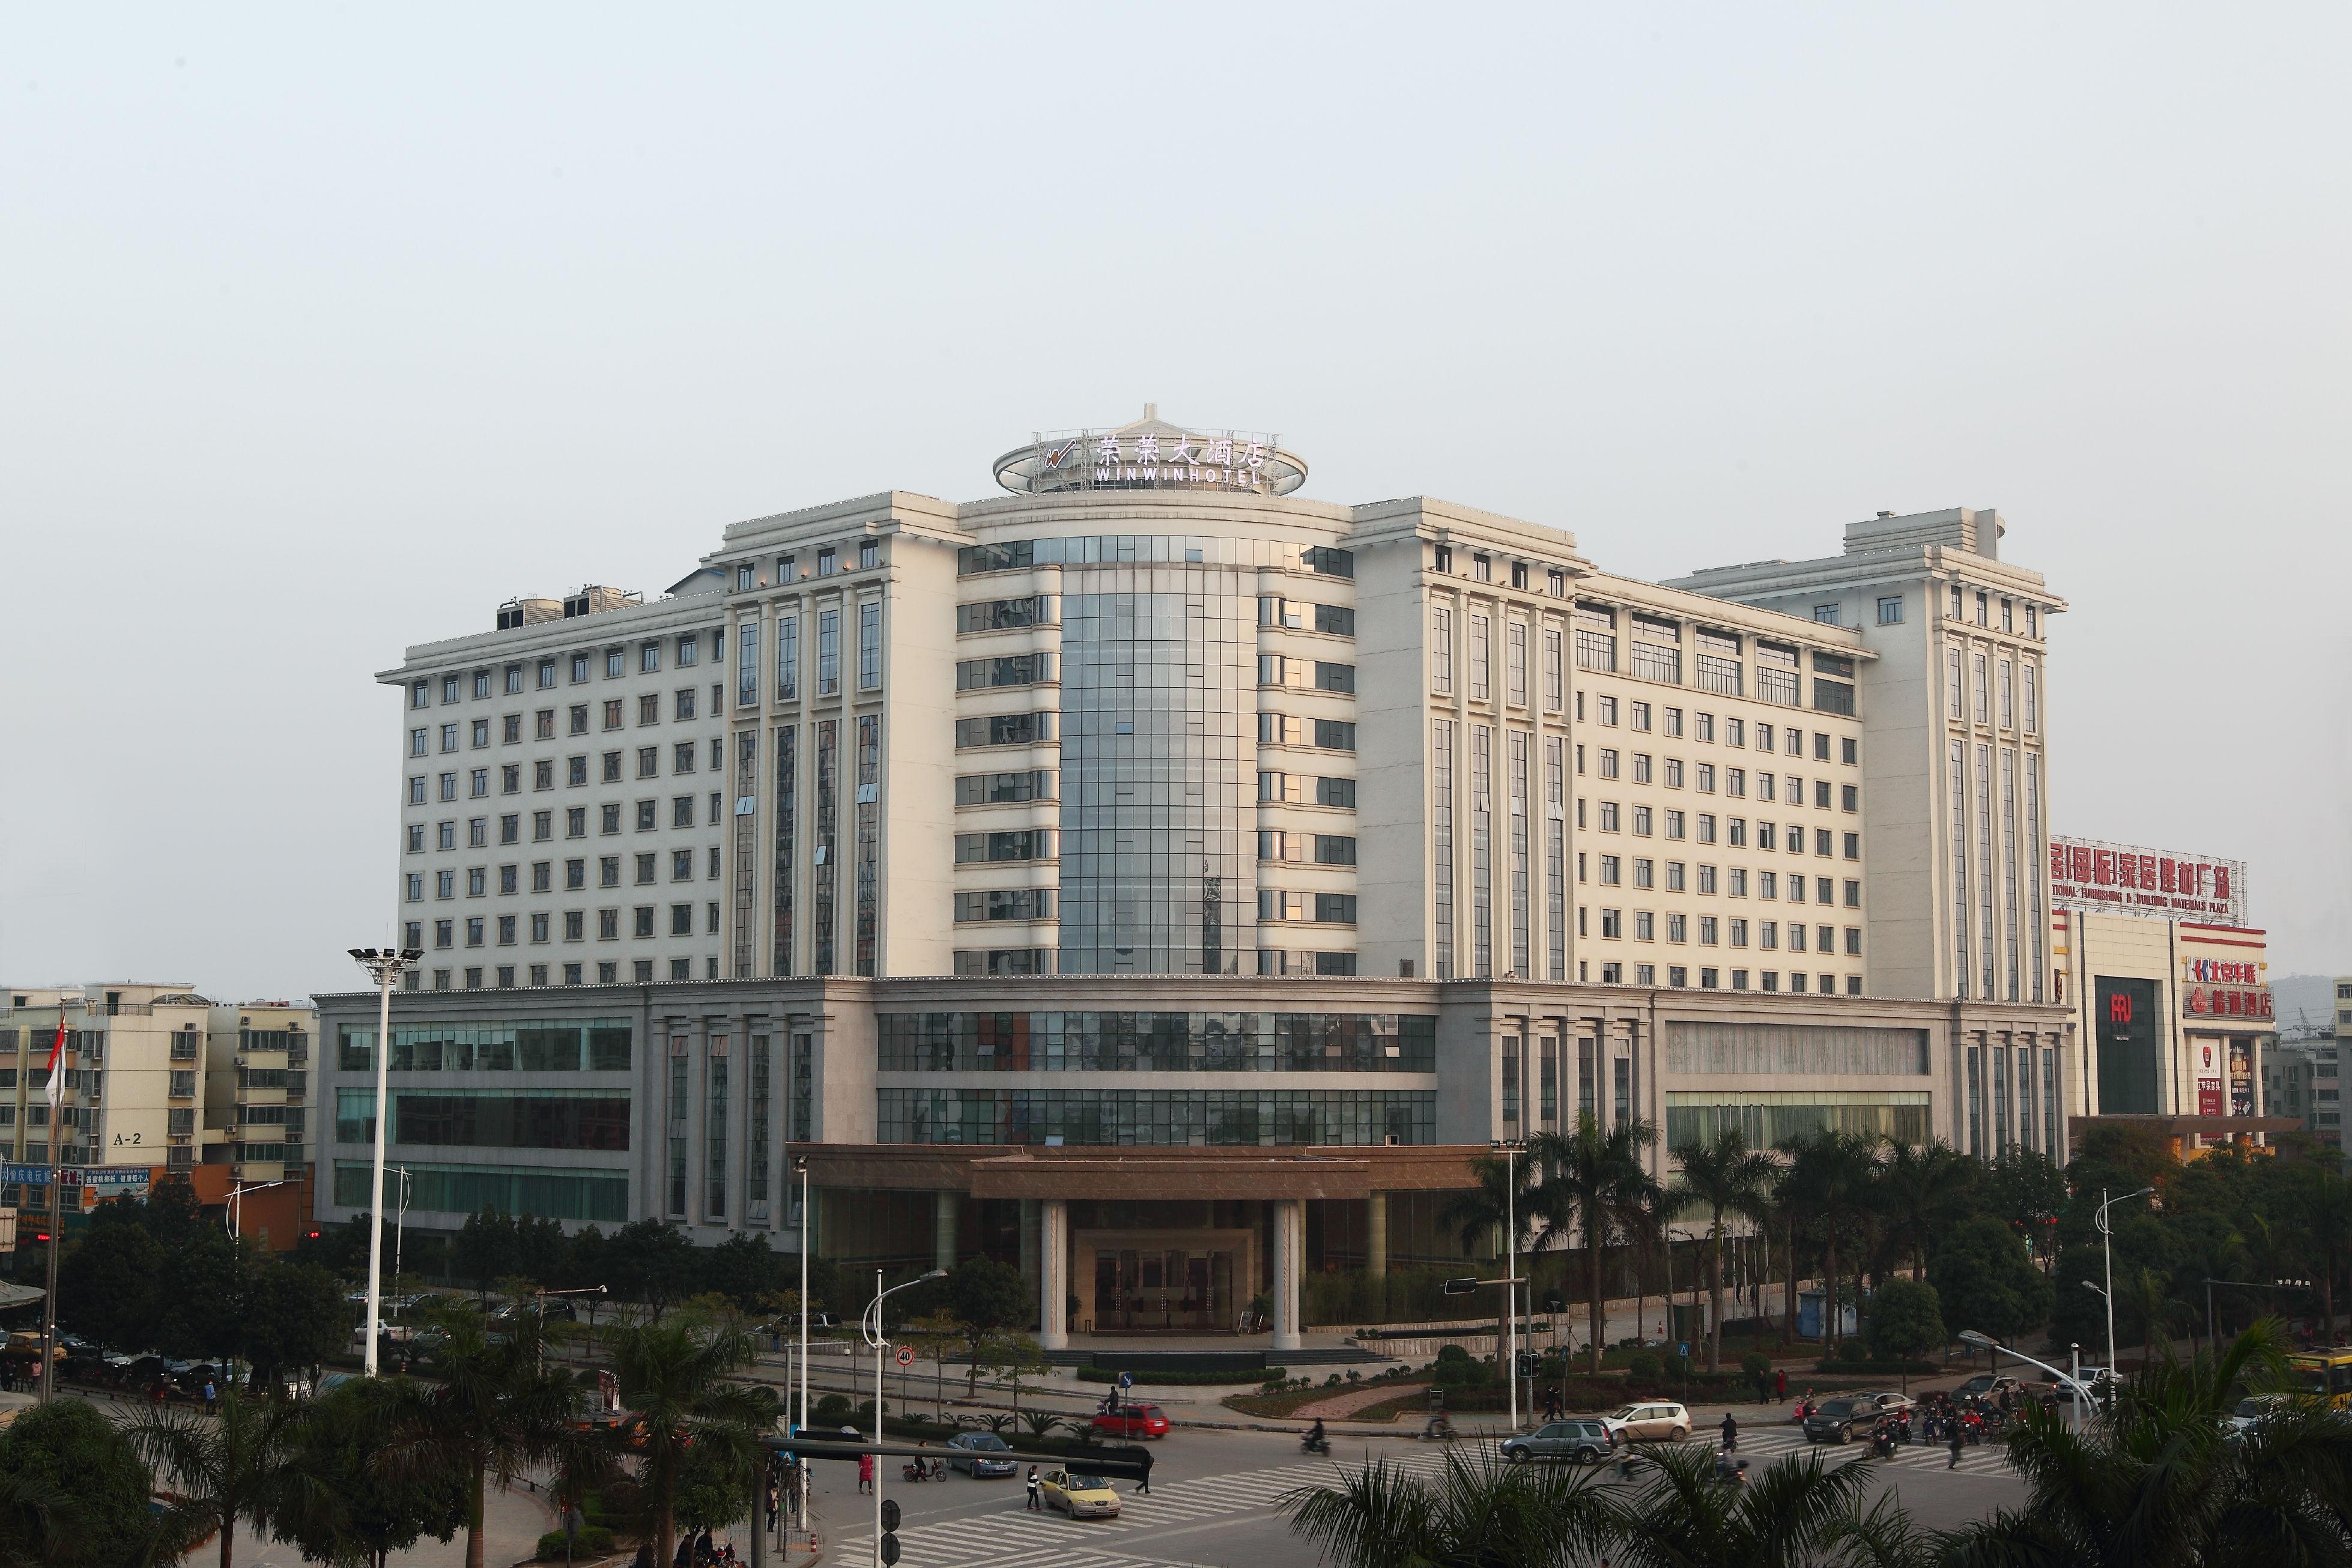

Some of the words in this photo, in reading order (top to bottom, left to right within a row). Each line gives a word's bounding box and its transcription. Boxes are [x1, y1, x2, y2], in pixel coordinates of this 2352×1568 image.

[1097, 433, 1264, 467] 荣荣大酒店
[2082, 887, 2123, 901] FURNISHING
[2127, 893, 2132, 903] &
[2136, 893, 2168, 907] BUILDING
[2171, 897, 2206, 912] MATERIALS
[2209, 902, 2229, 914] PLAZA
[2210, 961, 2256, 984] 北京华联
[2213, 989, 2272, 1017] 精通酒店
[114, 1133, 141, 1145] A-2
[900, 1352, 910, 1361] 40
